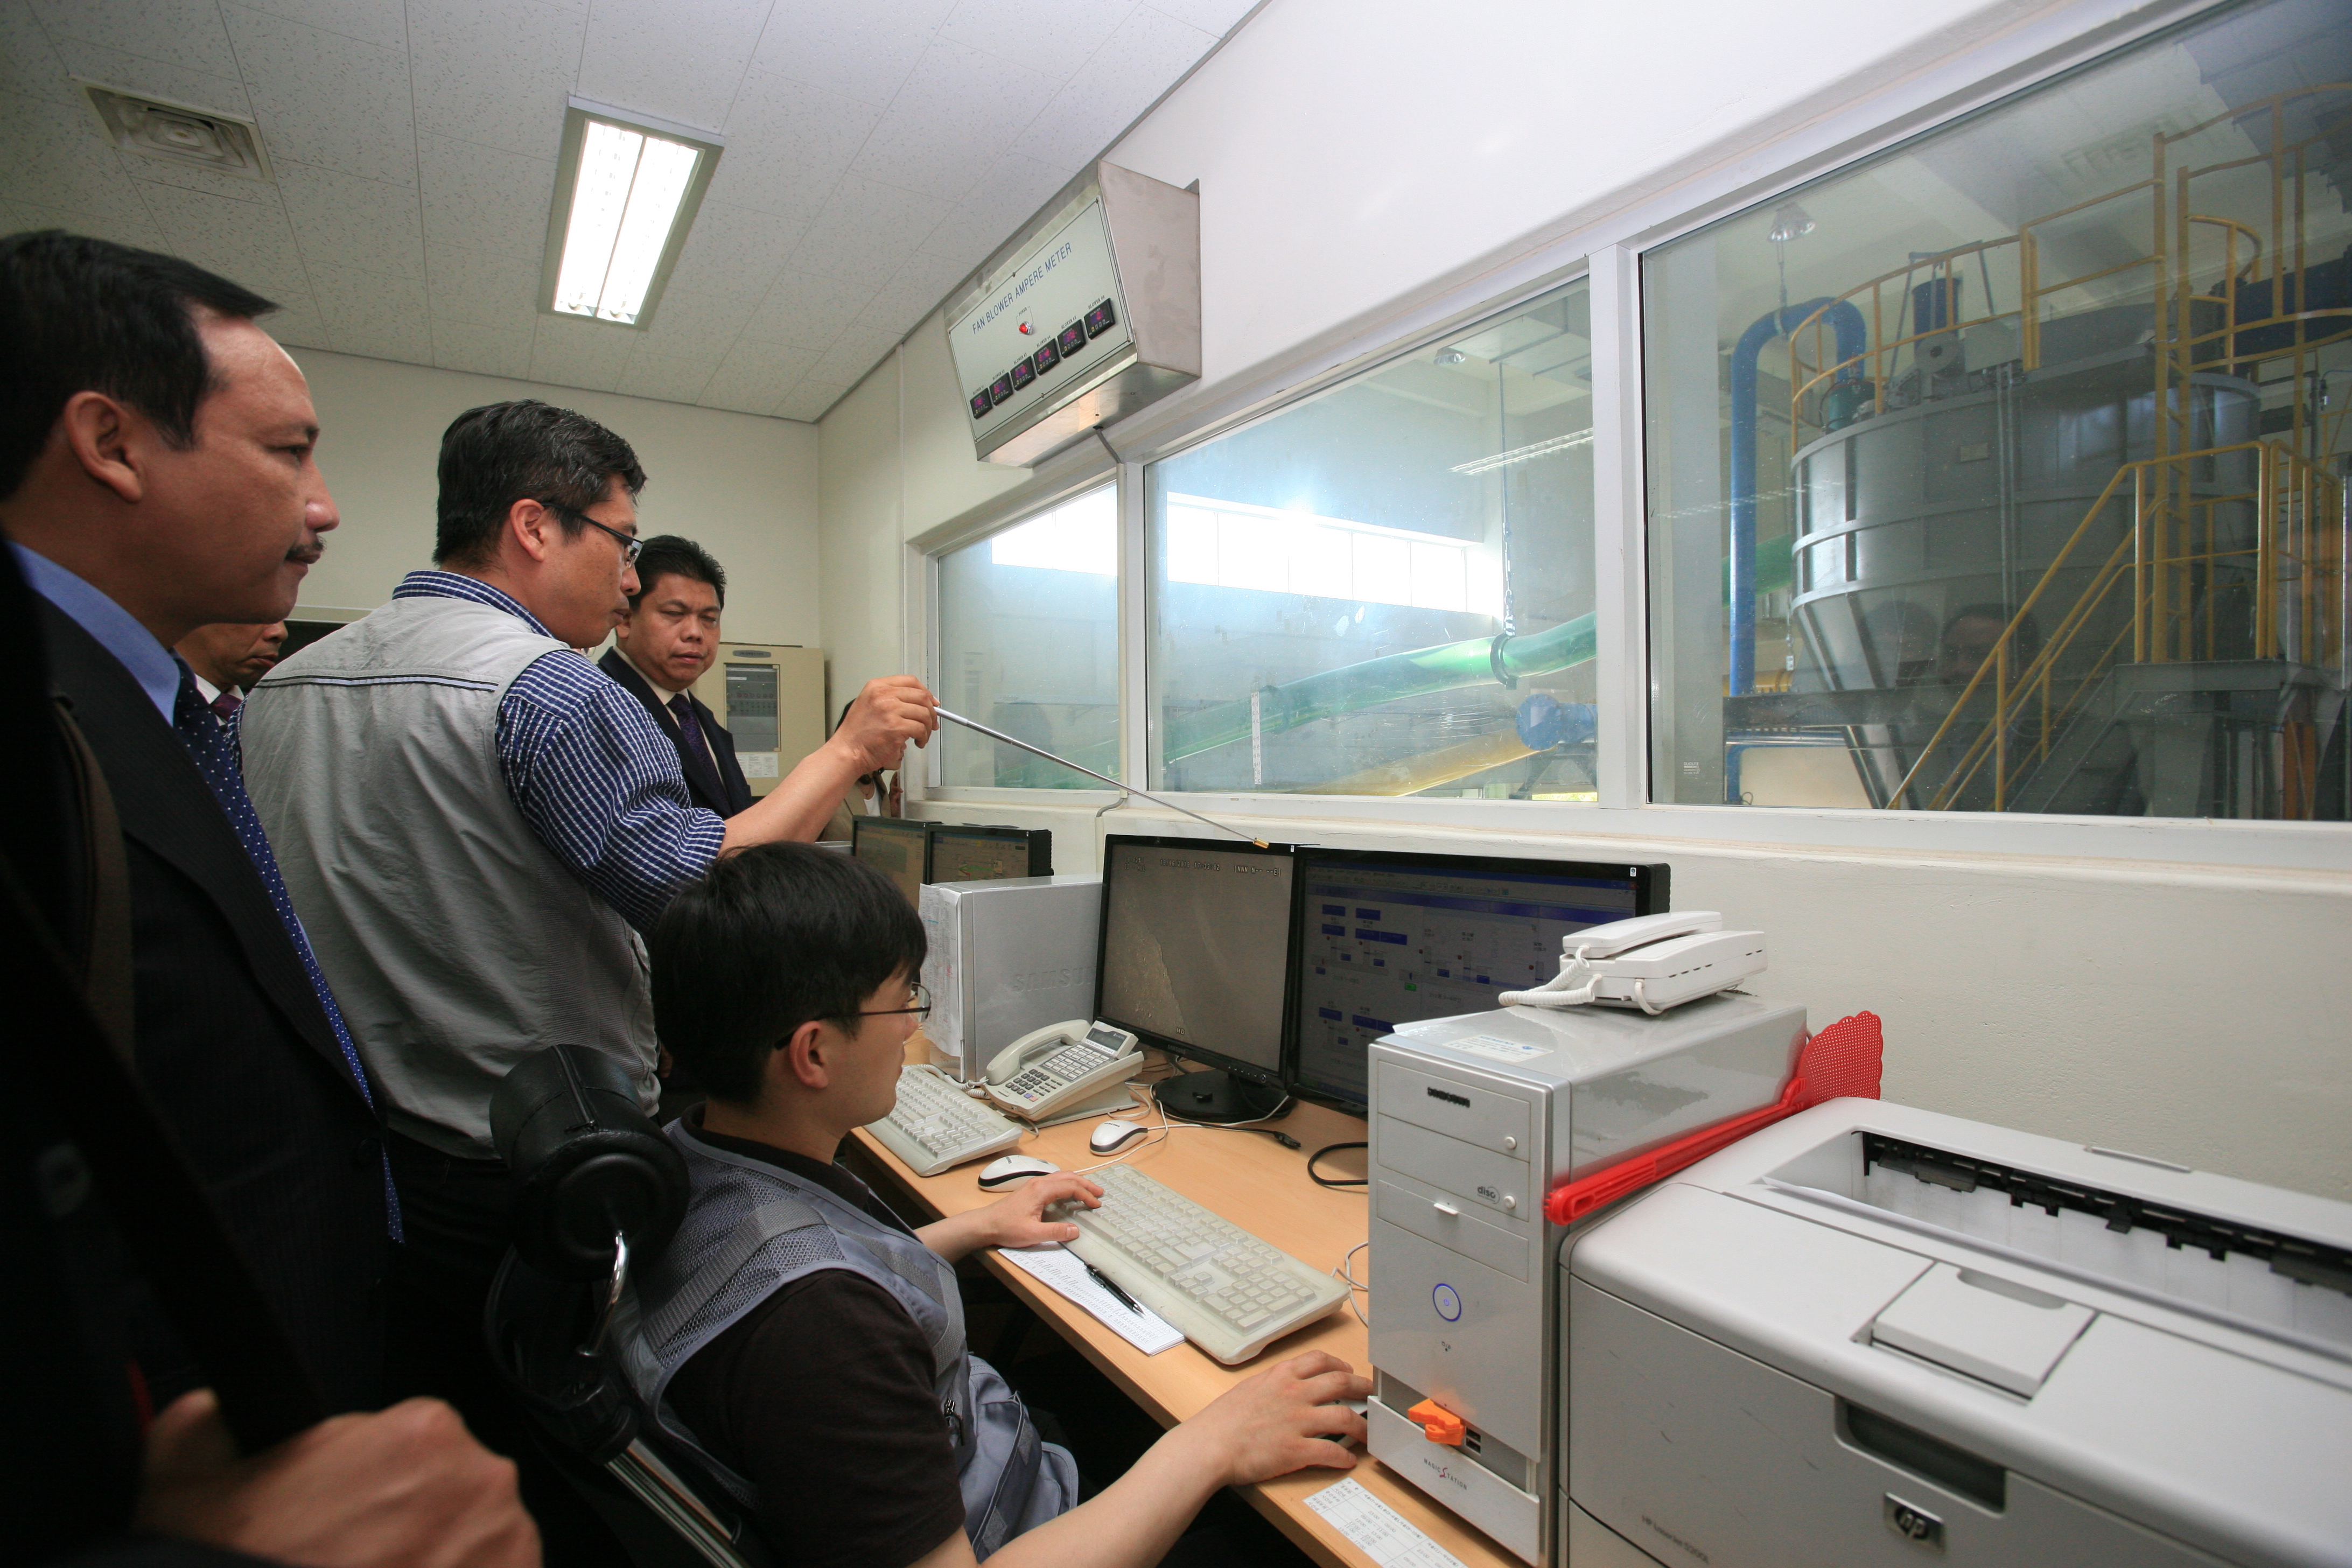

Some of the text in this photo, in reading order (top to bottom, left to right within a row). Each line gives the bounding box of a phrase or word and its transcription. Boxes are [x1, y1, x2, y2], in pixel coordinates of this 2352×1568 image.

[972, 242, 1072, 334] FAN BLOWER AMPERE METER
[1424, 1458, 1440, 1473] MAGIC
[1898, 1508, 1927, 1538] hp
